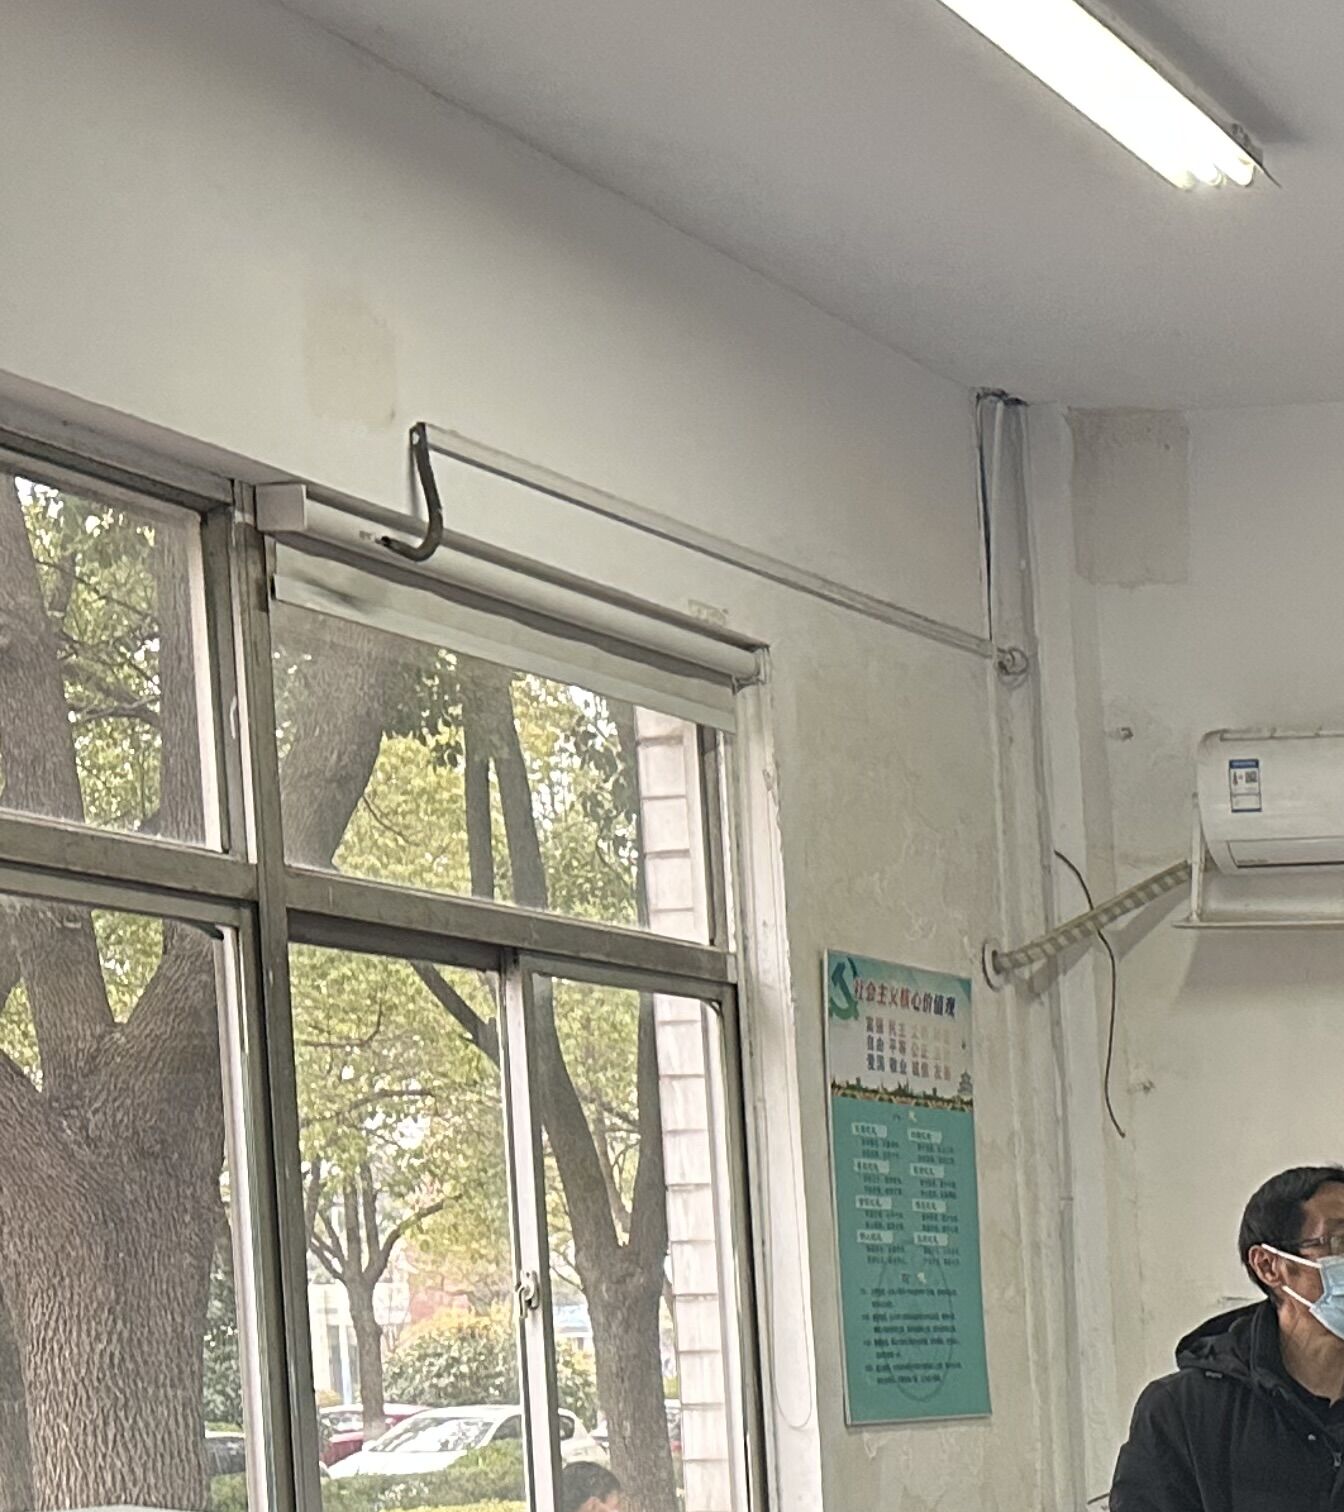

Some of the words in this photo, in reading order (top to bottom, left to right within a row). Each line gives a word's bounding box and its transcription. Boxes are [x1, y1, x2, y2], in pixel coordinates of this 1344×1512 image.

[854, 977, 957, 1018] 社会主义核心价值观
